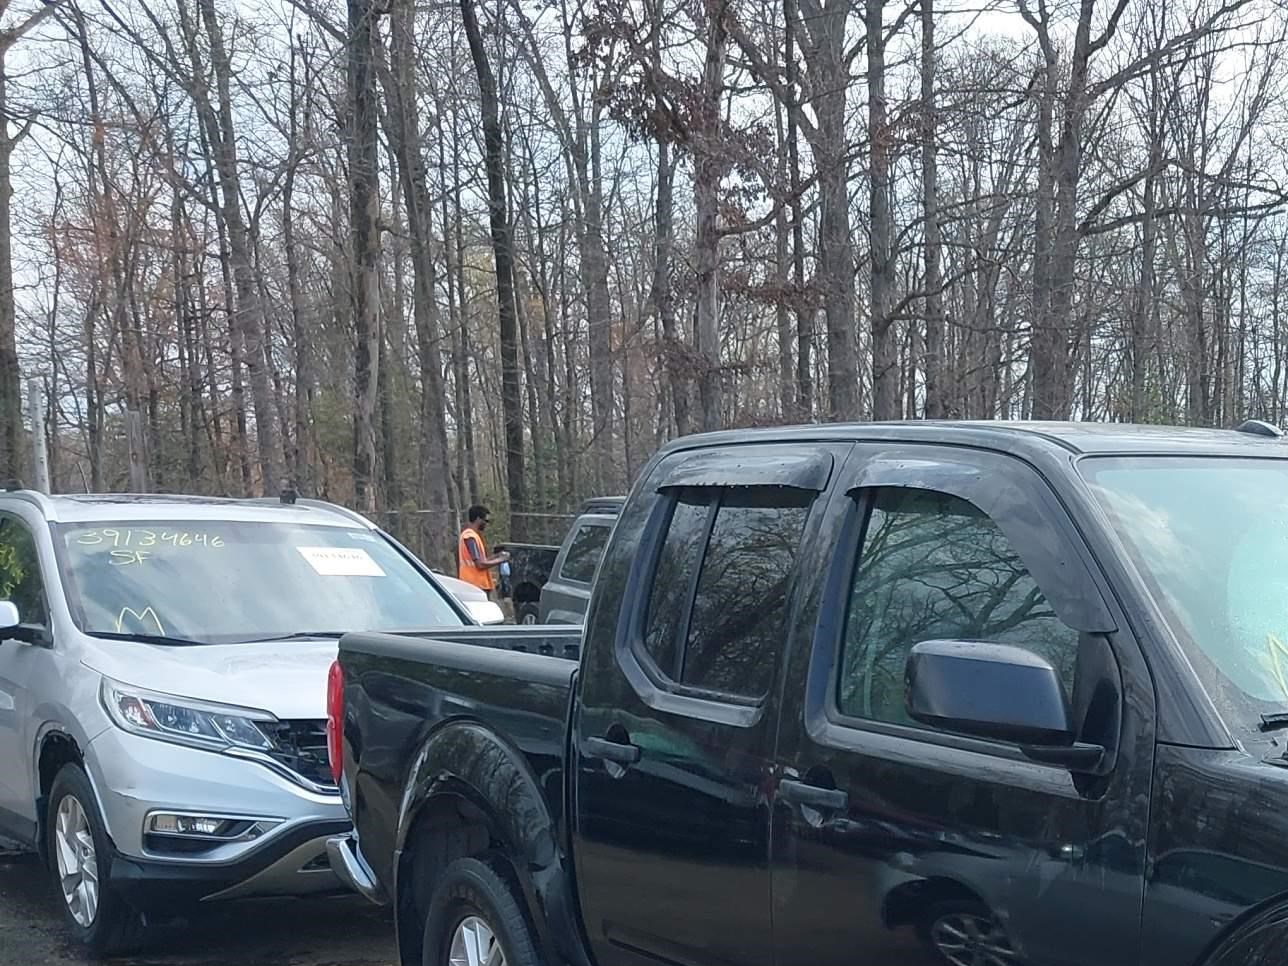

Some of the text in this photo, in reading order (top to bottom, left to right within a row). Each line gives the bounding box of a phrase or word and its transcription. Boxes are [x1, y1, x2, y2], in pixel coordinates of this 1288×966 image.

[77, 529, 225, 547] 39134646
[108, 550, 150, 565] SF
[115, 607, 165, 636] M
